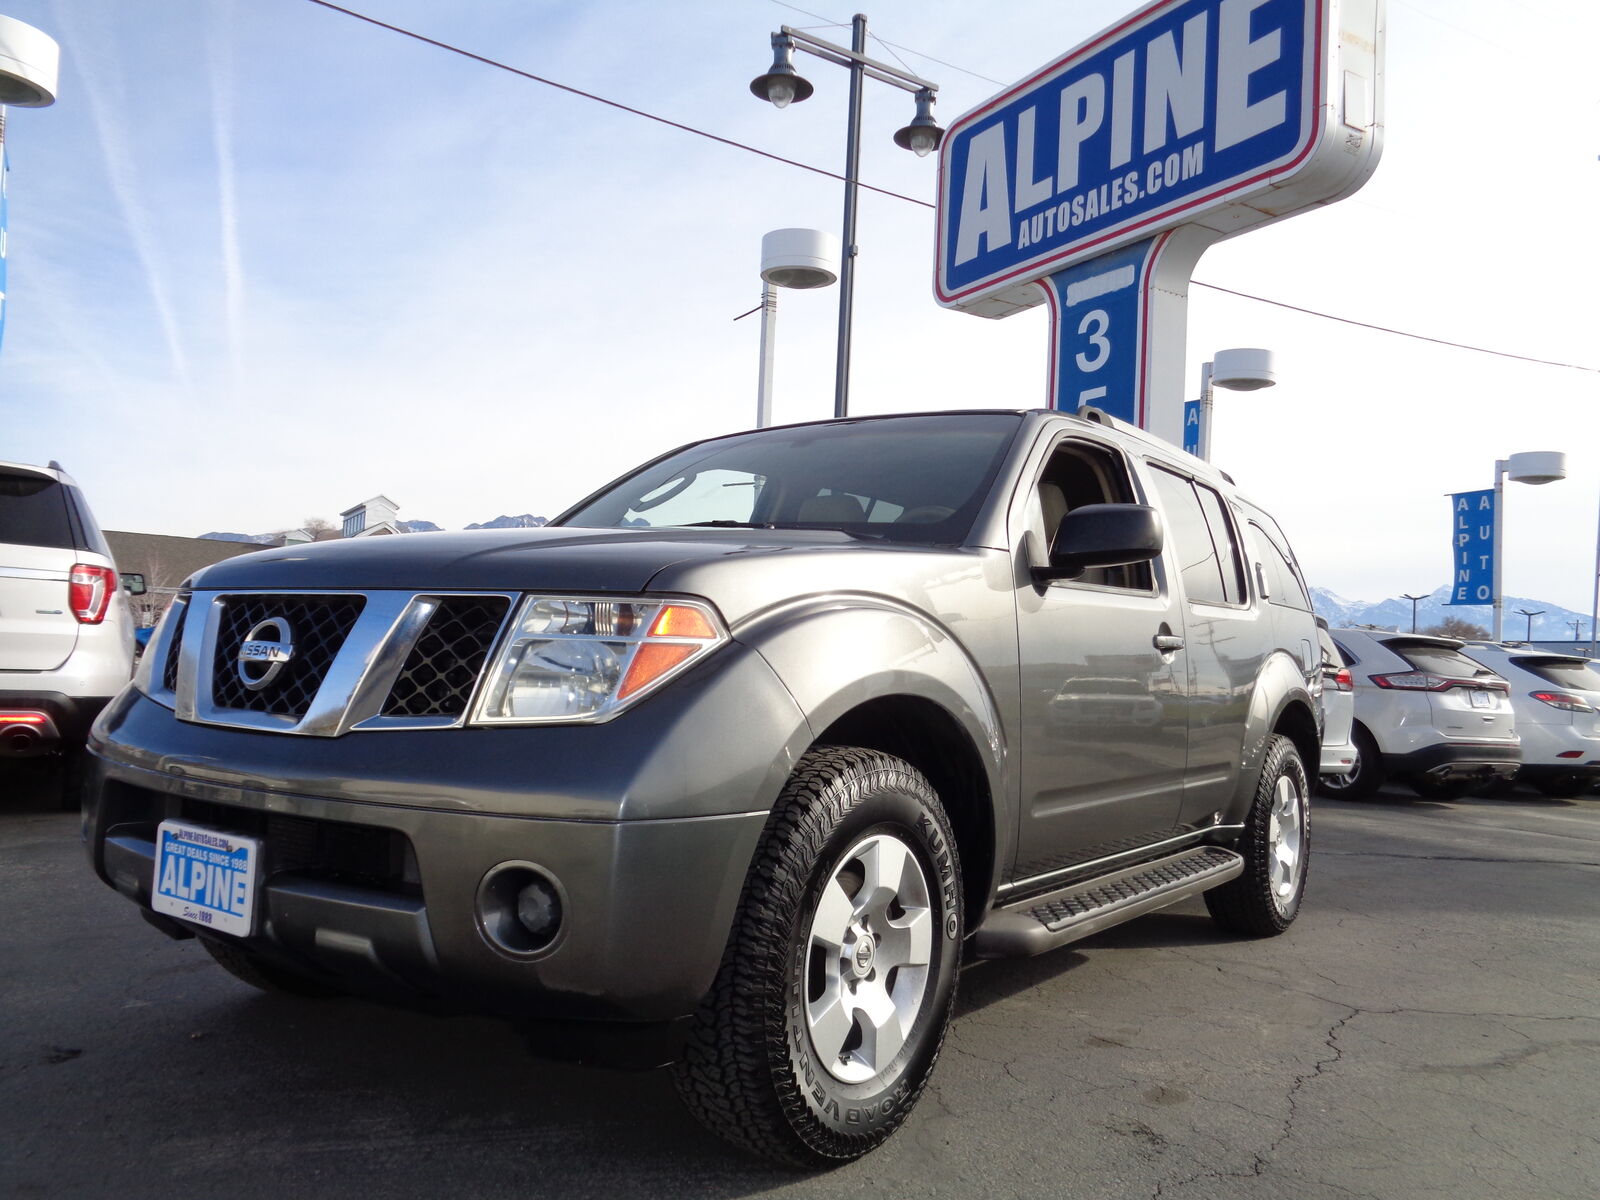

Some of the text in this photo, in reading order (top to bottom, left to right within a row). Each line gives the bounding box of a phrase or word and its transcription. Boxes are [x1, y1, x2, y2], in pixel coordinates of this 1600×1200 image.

[954, 0, 1286, 267] ALPINE
[1018, 141, 1204, 250] AUTOSALES.COM
[1457, 498, 1470, 600] ALPINE
[1476, 495, 1491, 600] AUTO
[240, 644, 280, 658] NISSAN
[160, 854, 247, 915] ALPINE
[165, 842, 186, 855] GREAT
[186, 846, 209, 861] DEALS
[208, 852, 230, 867] SINCE
[915, 811, 958, 941] KUMHO
